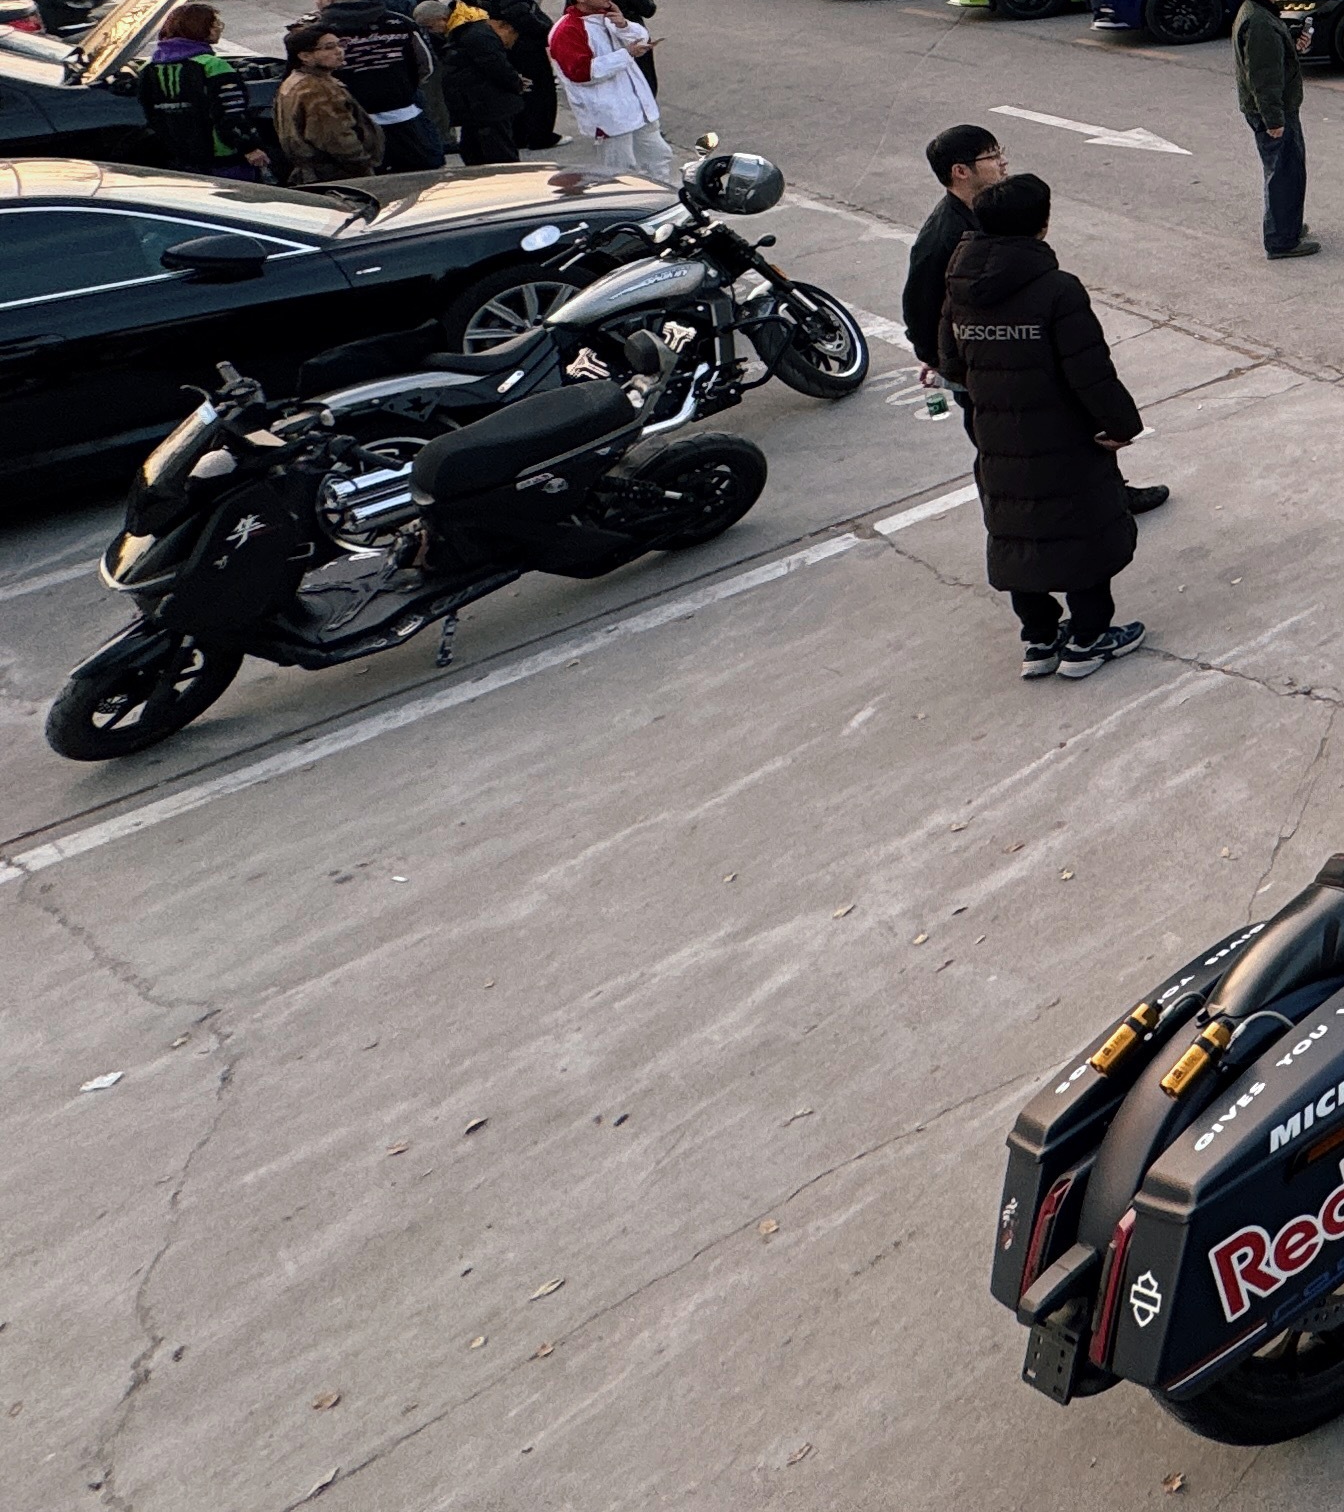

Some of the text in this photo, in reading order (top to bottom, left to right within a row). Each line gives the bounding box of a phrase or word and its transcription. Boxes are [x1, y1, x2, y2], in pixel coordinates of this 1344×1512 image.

[1156, 974, 1196, 1005] YO
[1194, 1080, 1267, 1152] GIVES
[1275, 1023, 1329, 1067] YOU
